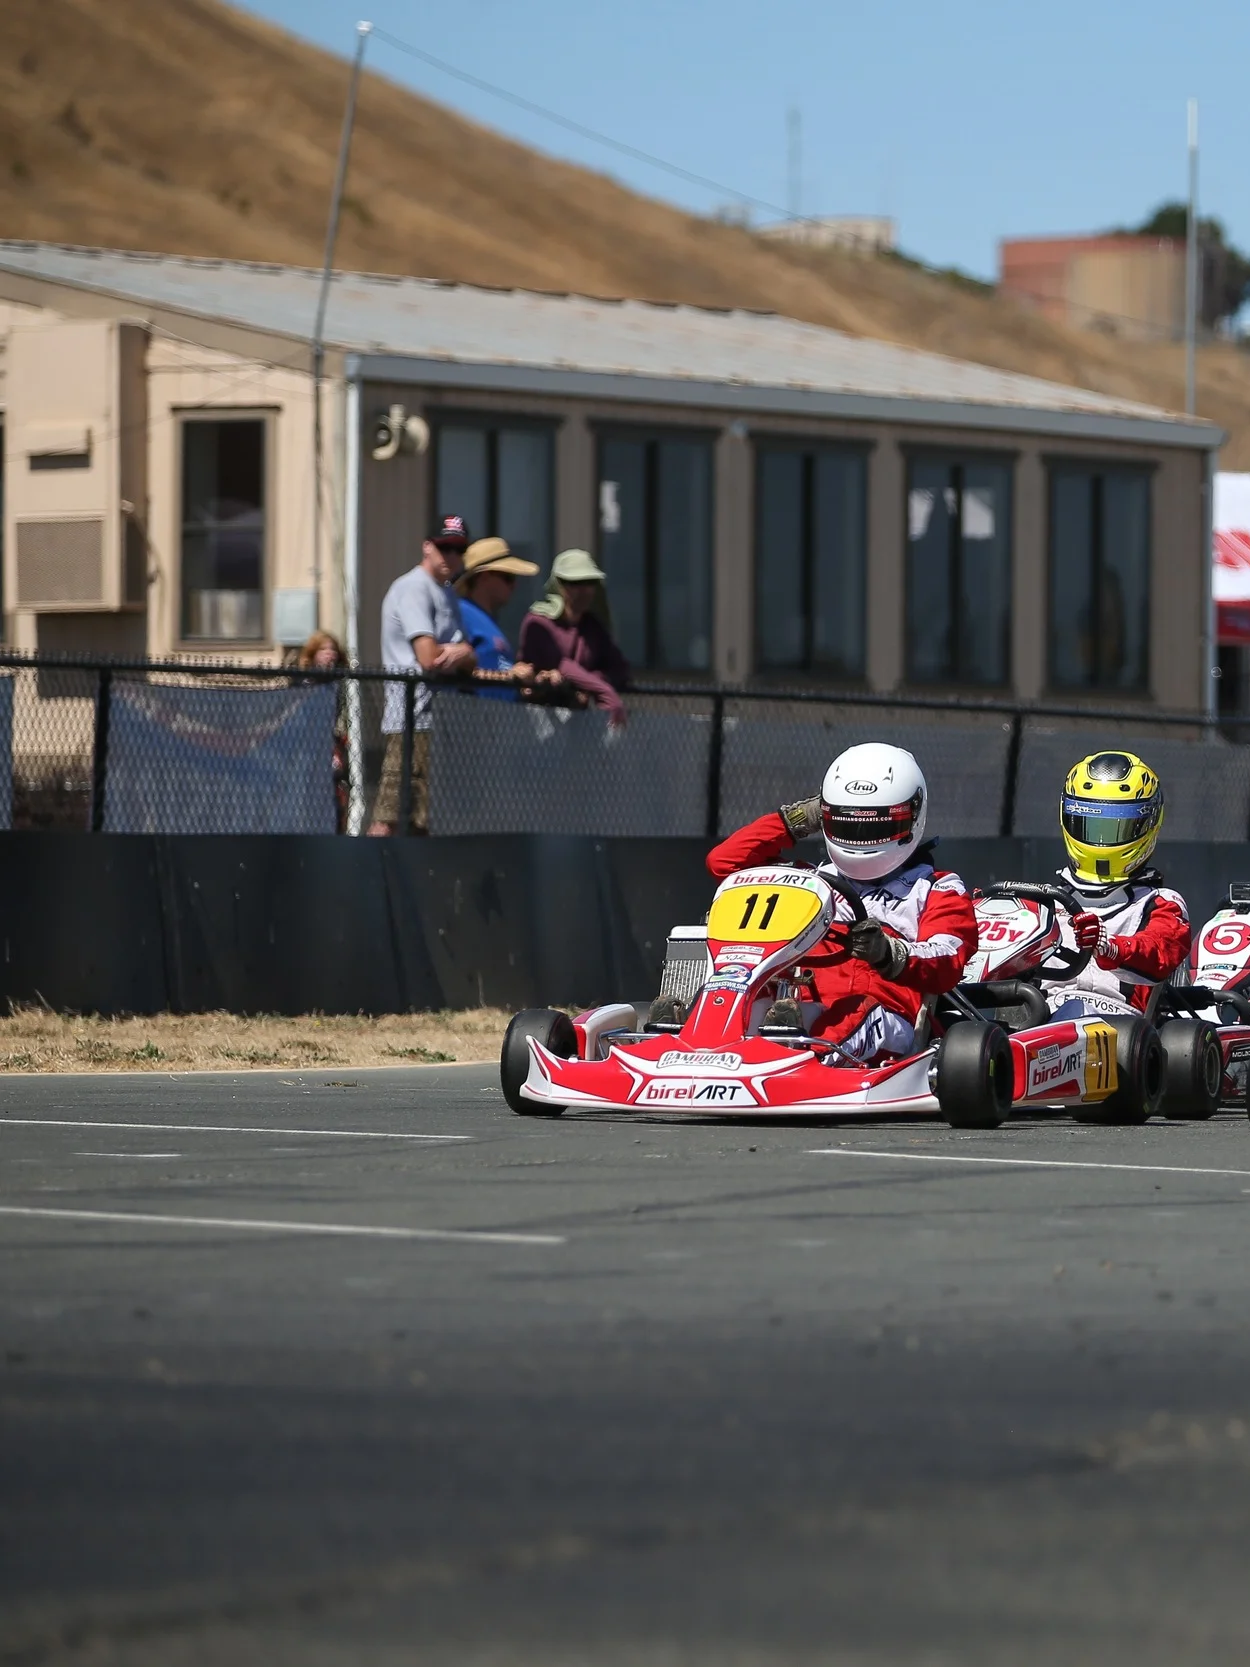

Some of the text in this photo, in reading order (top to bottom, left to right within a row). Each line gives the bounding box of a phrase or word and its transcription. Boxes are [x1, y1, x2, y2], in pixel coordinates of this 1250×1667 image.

[850, 781, 873, 791] Arai
[733, 874, 812, 885] birelART
[738, 893, 780, 930] 11
[1212, 925, 1244, 952] 5
[663, 1052, 738, 1064] CAMBRIAN
[1032, 1050, 1082, 1086] birelART
[1095, 1030, 1109, 1089] 11
[646, 1084, 742, 1100] birelART
